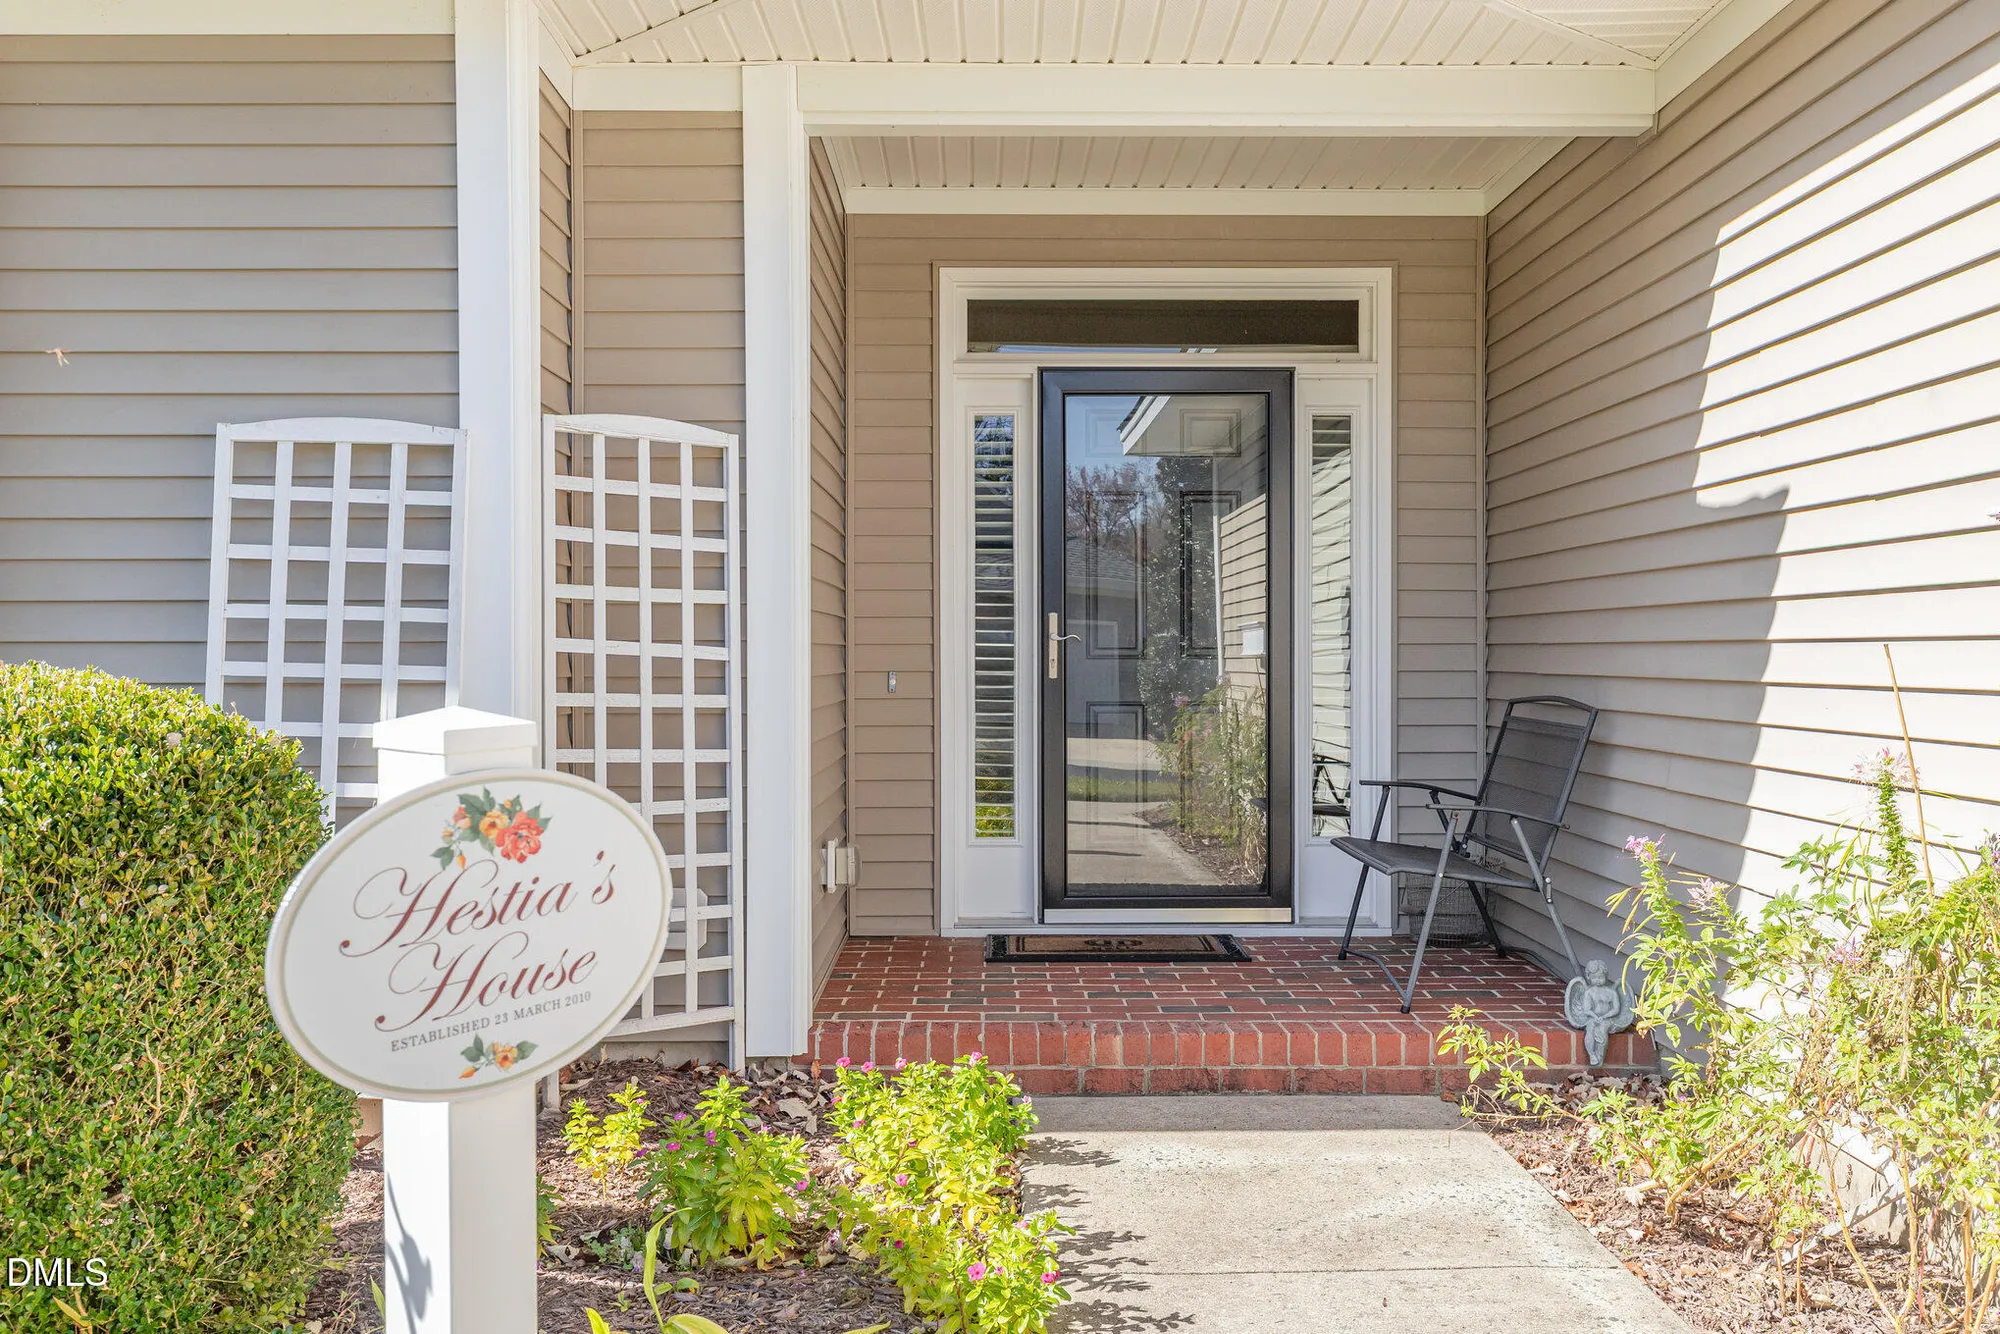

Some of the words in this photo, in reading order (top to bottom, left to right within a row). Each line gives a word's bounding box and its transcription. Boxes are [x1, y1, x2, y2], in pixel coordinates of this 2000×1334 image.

[338, 850, 616, 958] Hestia's
[374, 931, 598, 1032] House
[390, 1017, 491, 1052] ESTABLISHED
[494, 1012, 509, 1025] 23
[513, 998, 562, 1021] MARCH
[565, 990, 592, 1007] 2010
